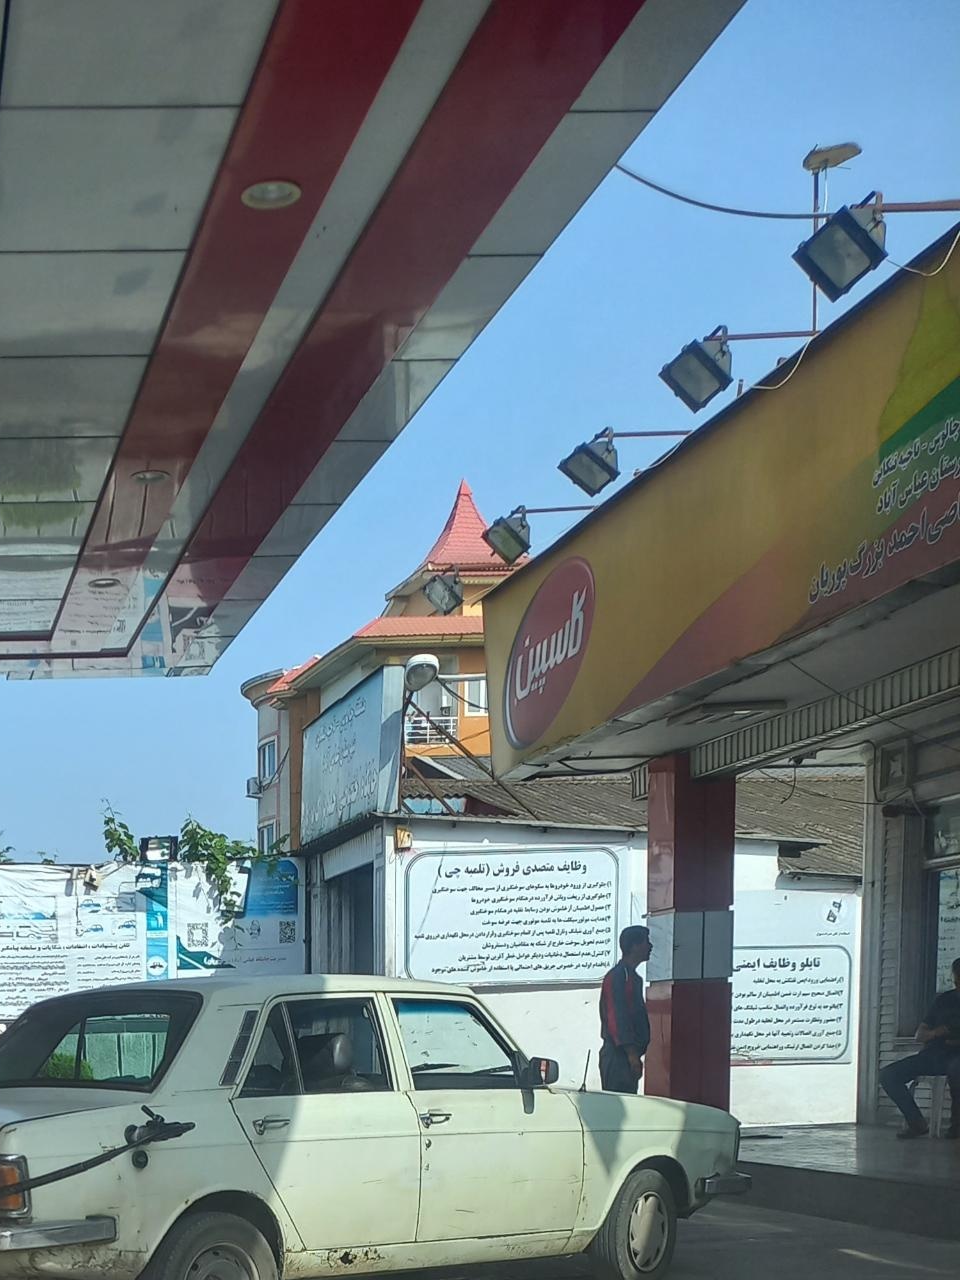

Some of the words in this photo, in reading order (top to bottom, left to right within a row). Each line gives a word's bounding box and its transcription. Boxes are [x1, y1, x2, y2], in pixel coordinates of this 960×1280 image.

[887, 506, 928, 557] احمد
[848, 539, 886, 579] بزرگ
[515, 585, 587, 700] کاسپین
[493, 861, 520, 878] فروش
[522, 862, 555, 877] متصدی
[557, 860, 588, 875] وظایف
[763, 957, 797, 972] وظایف
[800, 957, 821, 972] تابلو
